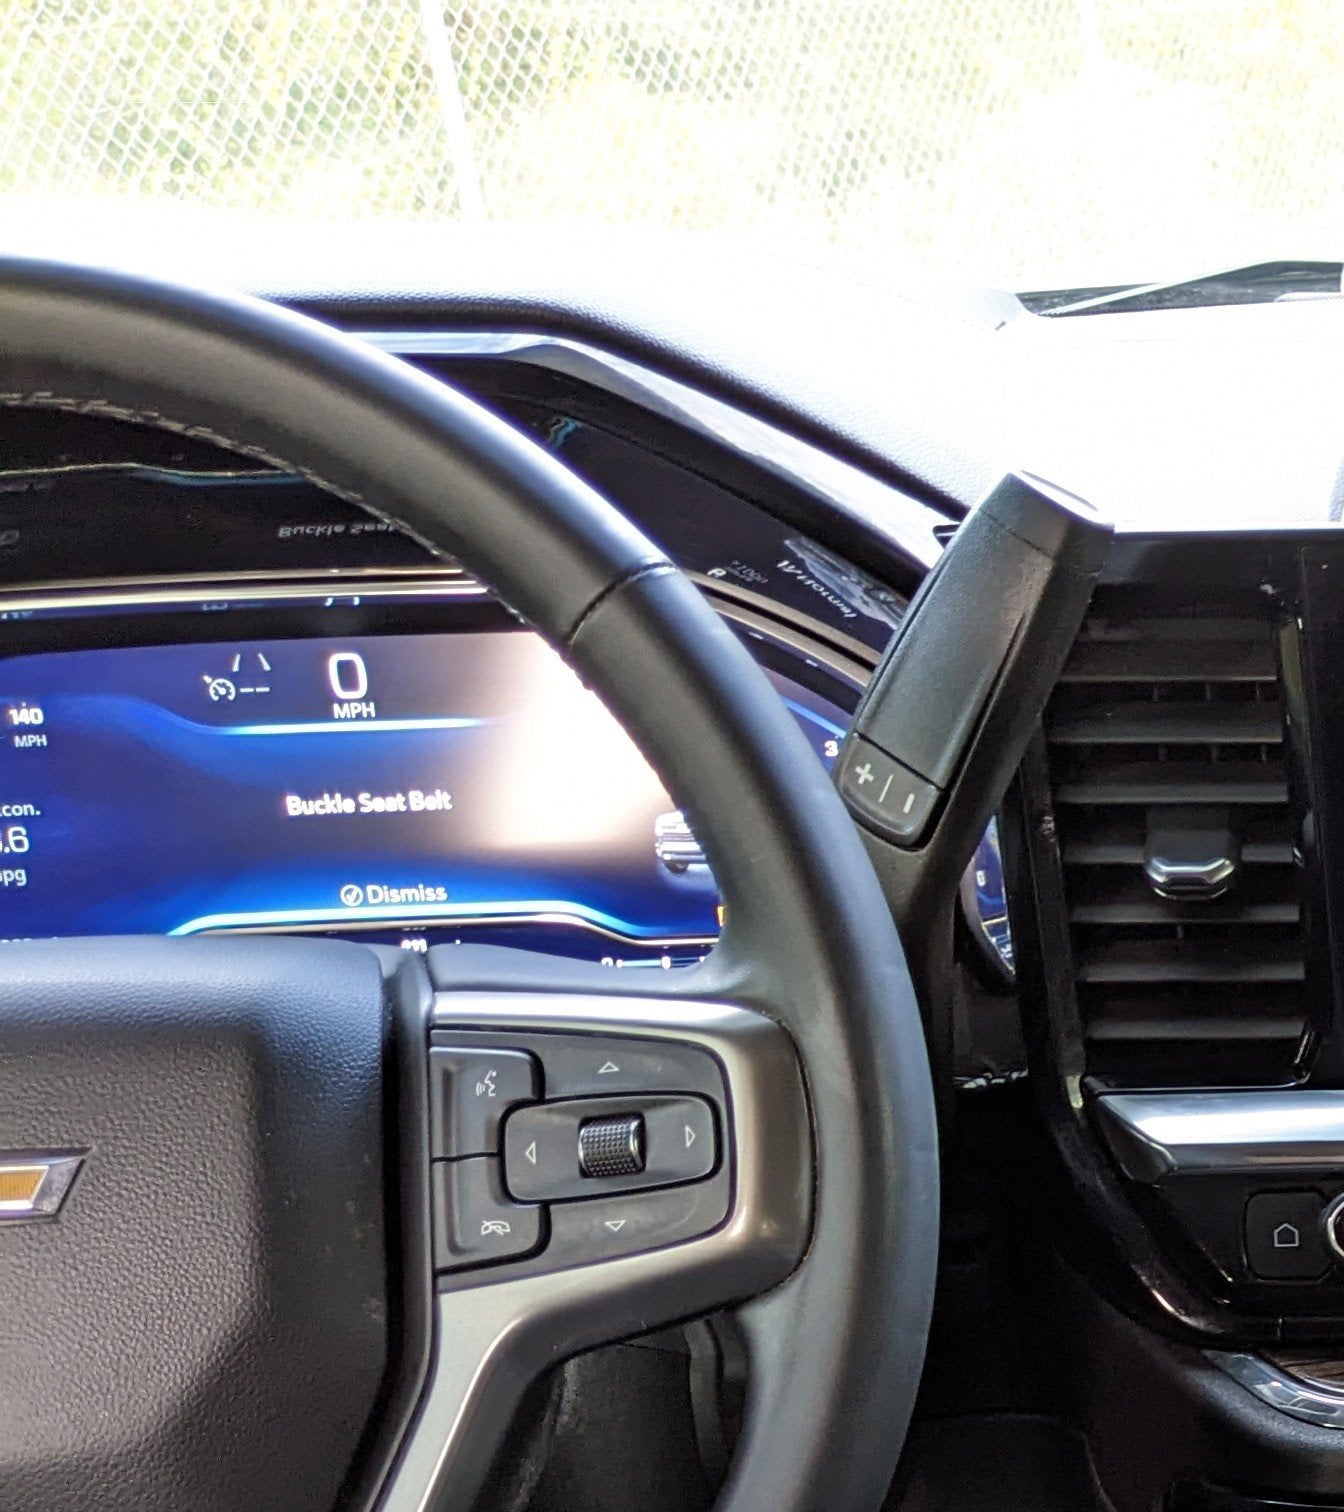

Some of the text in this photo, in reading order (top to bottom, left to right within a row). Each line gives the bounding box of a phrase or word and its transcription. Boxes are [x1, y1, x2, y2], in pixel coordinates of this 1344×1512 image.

[328, 652, 368, 700] 0
[8, 706, 44, 725] 140
[332, 702, 376, 719] MPH
[13, 734, 48, 748] MPH
[285, 789, 453, 816] Buckle Seat Belt
[366, 884, 448, 904] Dismiss
